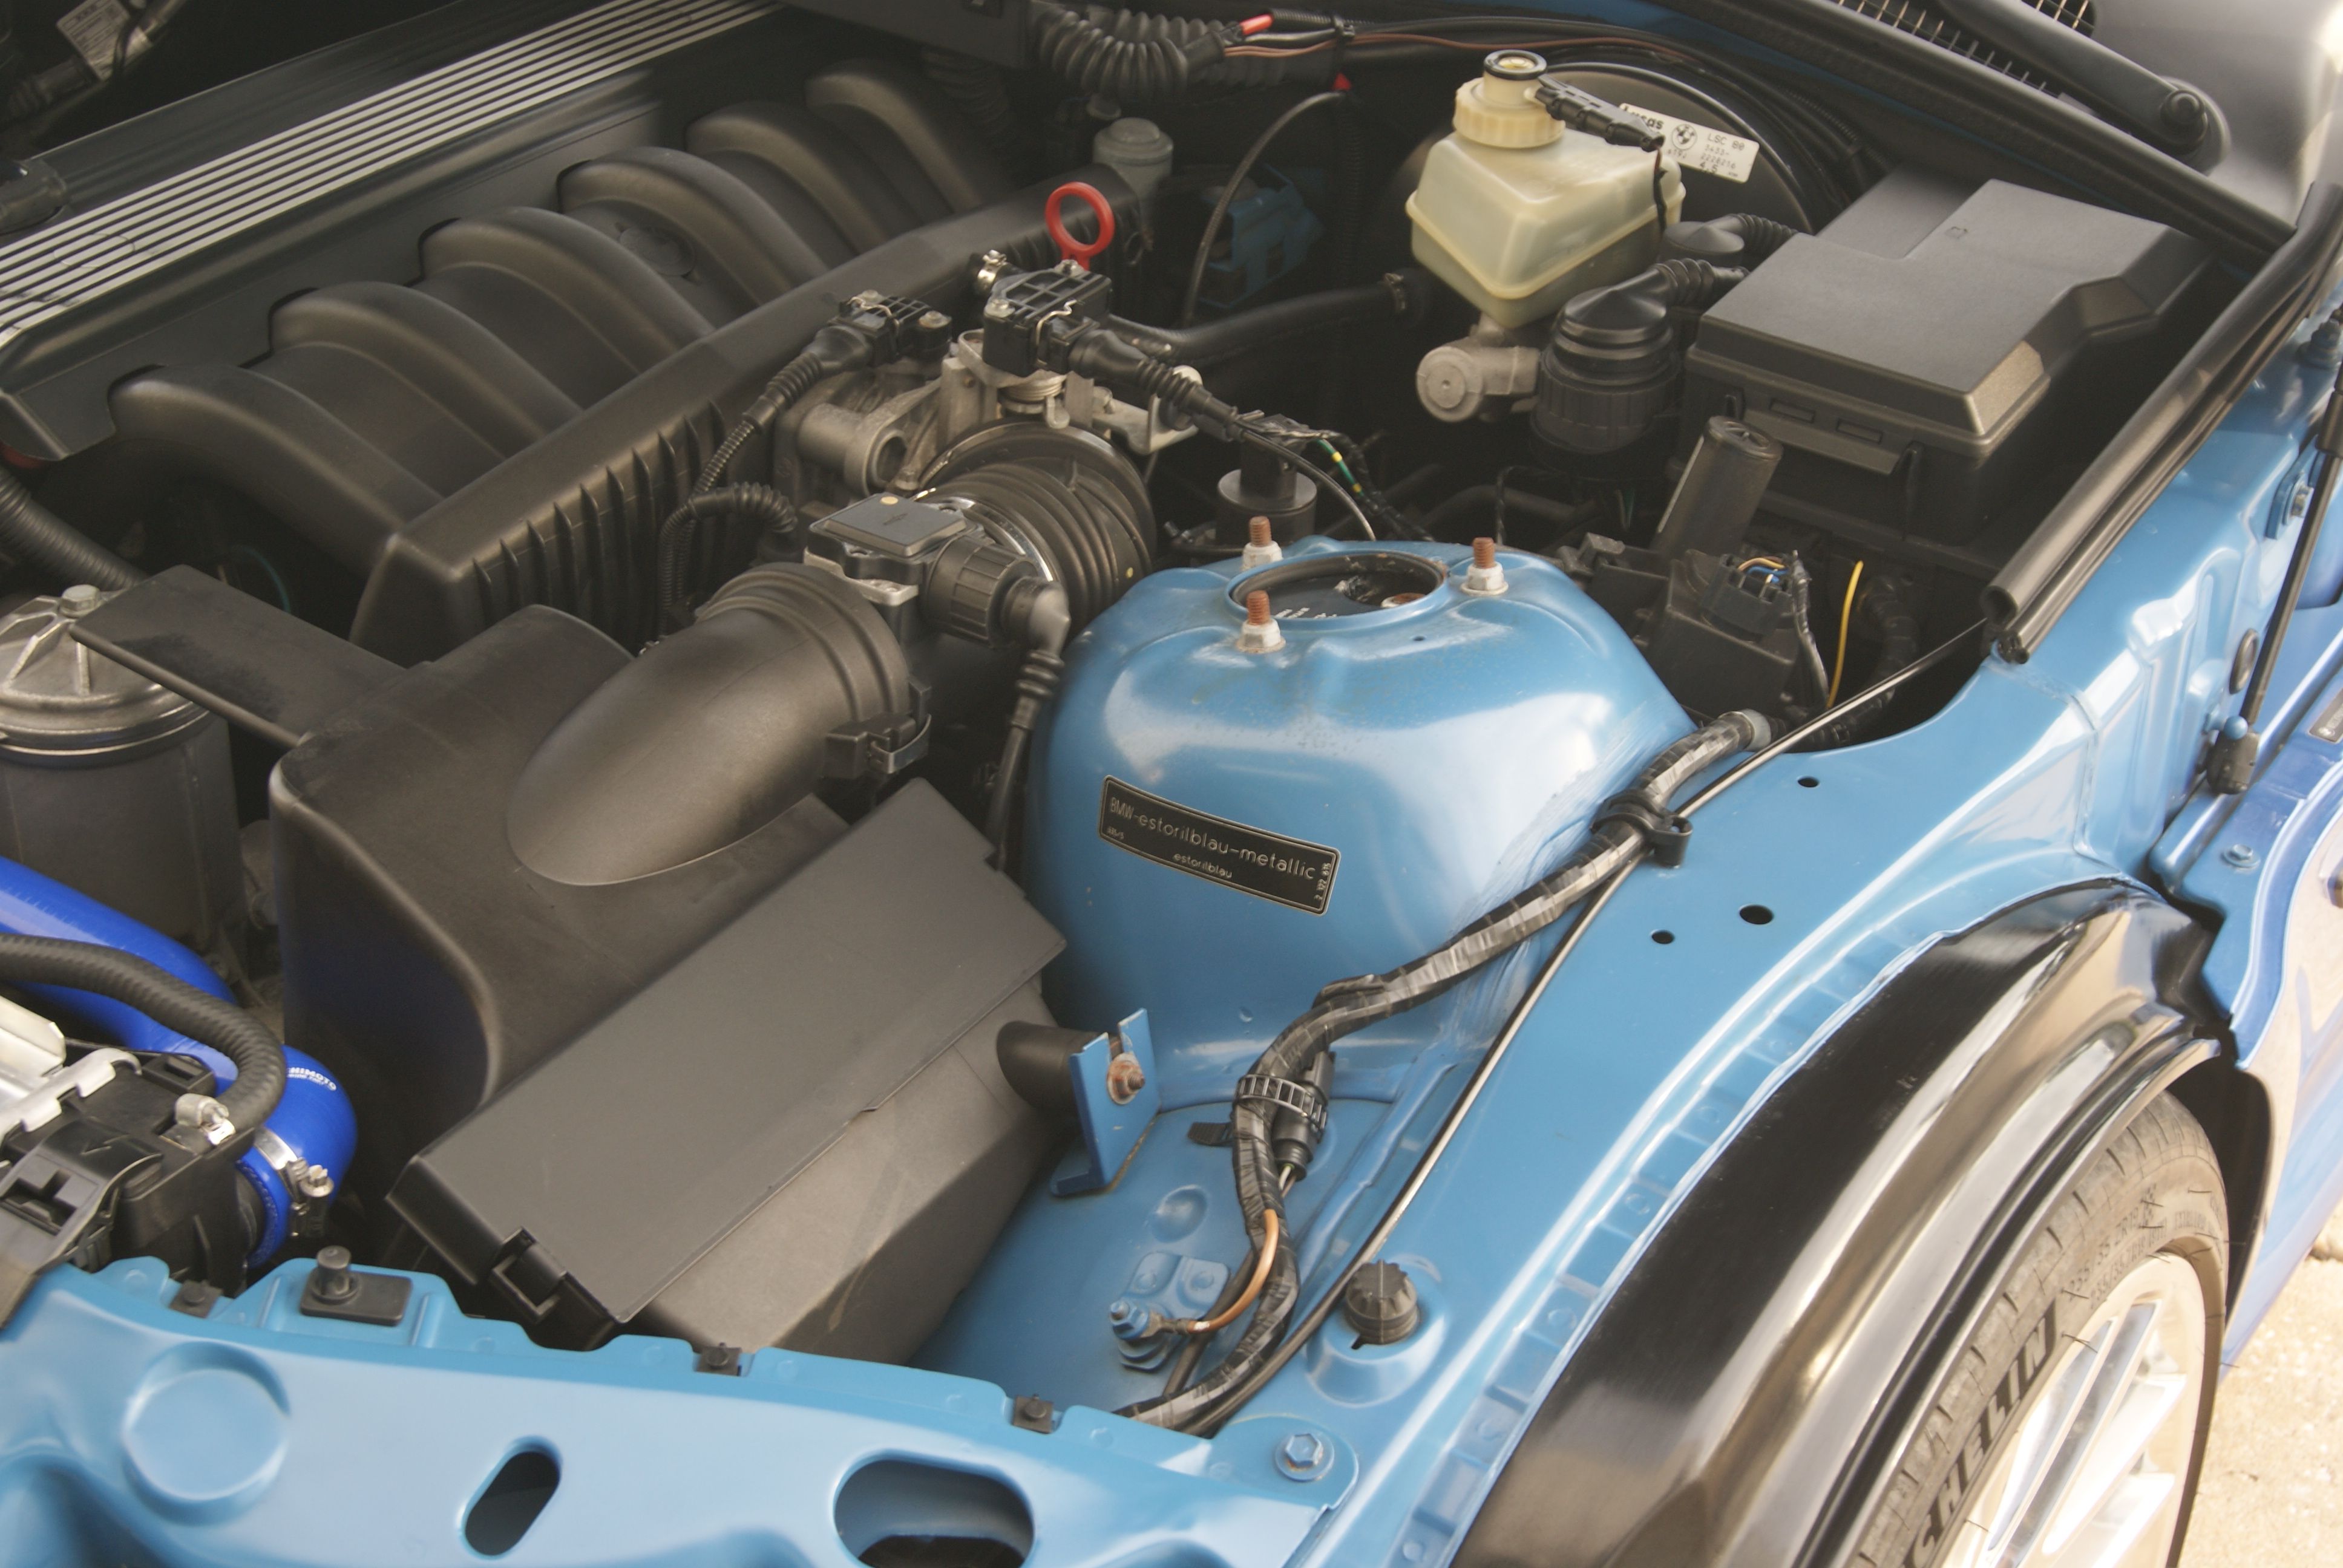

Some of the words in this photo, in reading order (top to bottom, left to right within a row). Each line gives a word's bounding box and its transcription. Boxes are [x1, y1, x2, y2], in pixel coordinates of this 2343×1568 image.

[1708, 134, 1727, 145] LSC
[1110, 797, 1316, 880] BMW-estorilblau-metallic
[1173, 852, 1233, 880] estorilblau
[286, 1067, 337, 1091] HIMOTO
